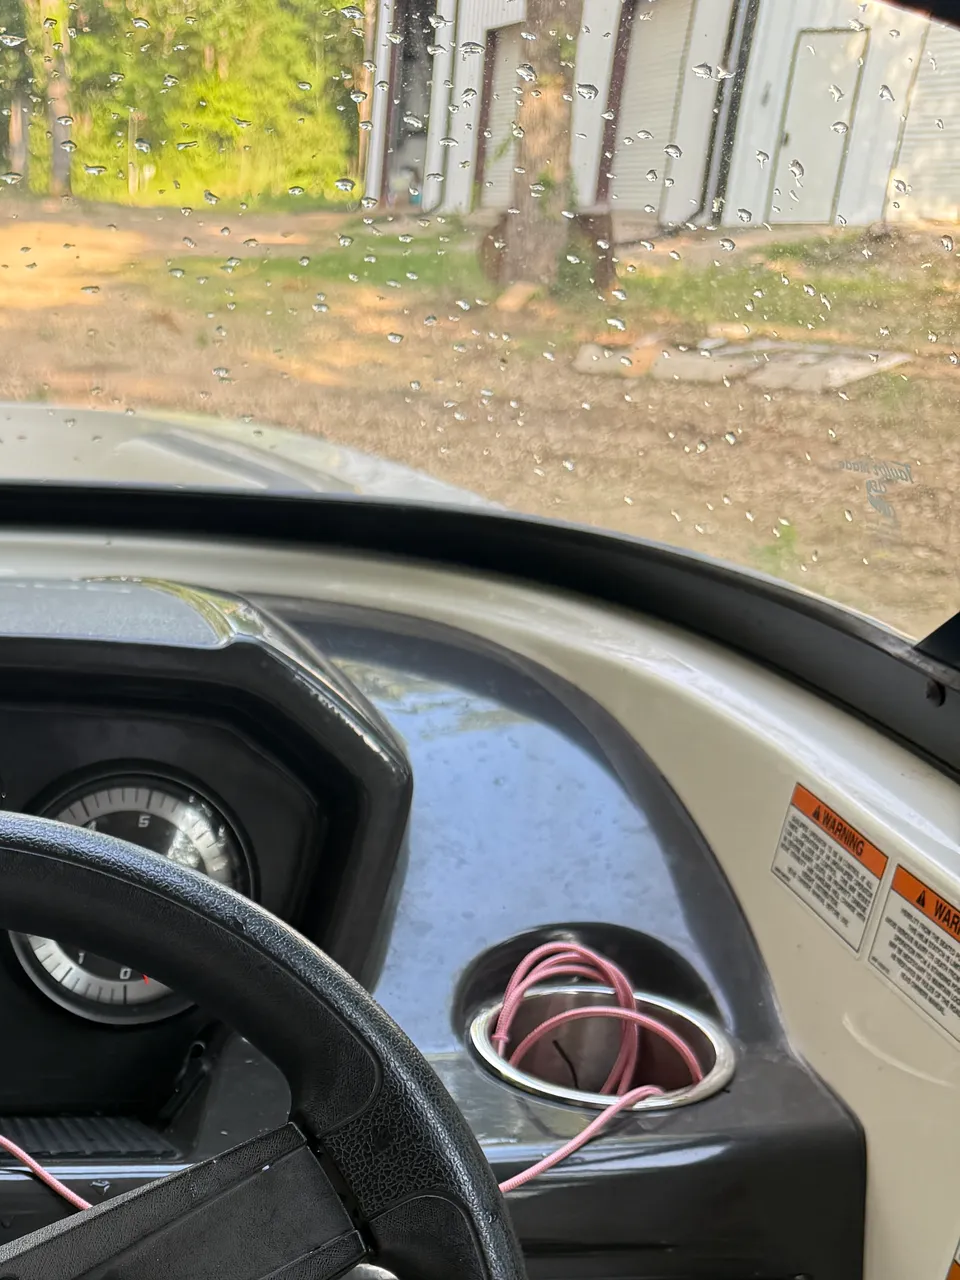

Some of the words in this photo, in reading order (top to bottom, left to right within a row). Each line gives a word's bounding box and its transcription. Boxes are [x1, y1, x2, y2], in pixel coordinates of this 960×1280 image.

[139, 814, 150, 828] 5
[822, 808, 864, 857] WARNING
[78, 952, 85, 965] 1
[119, 968, 132, 980] 0
